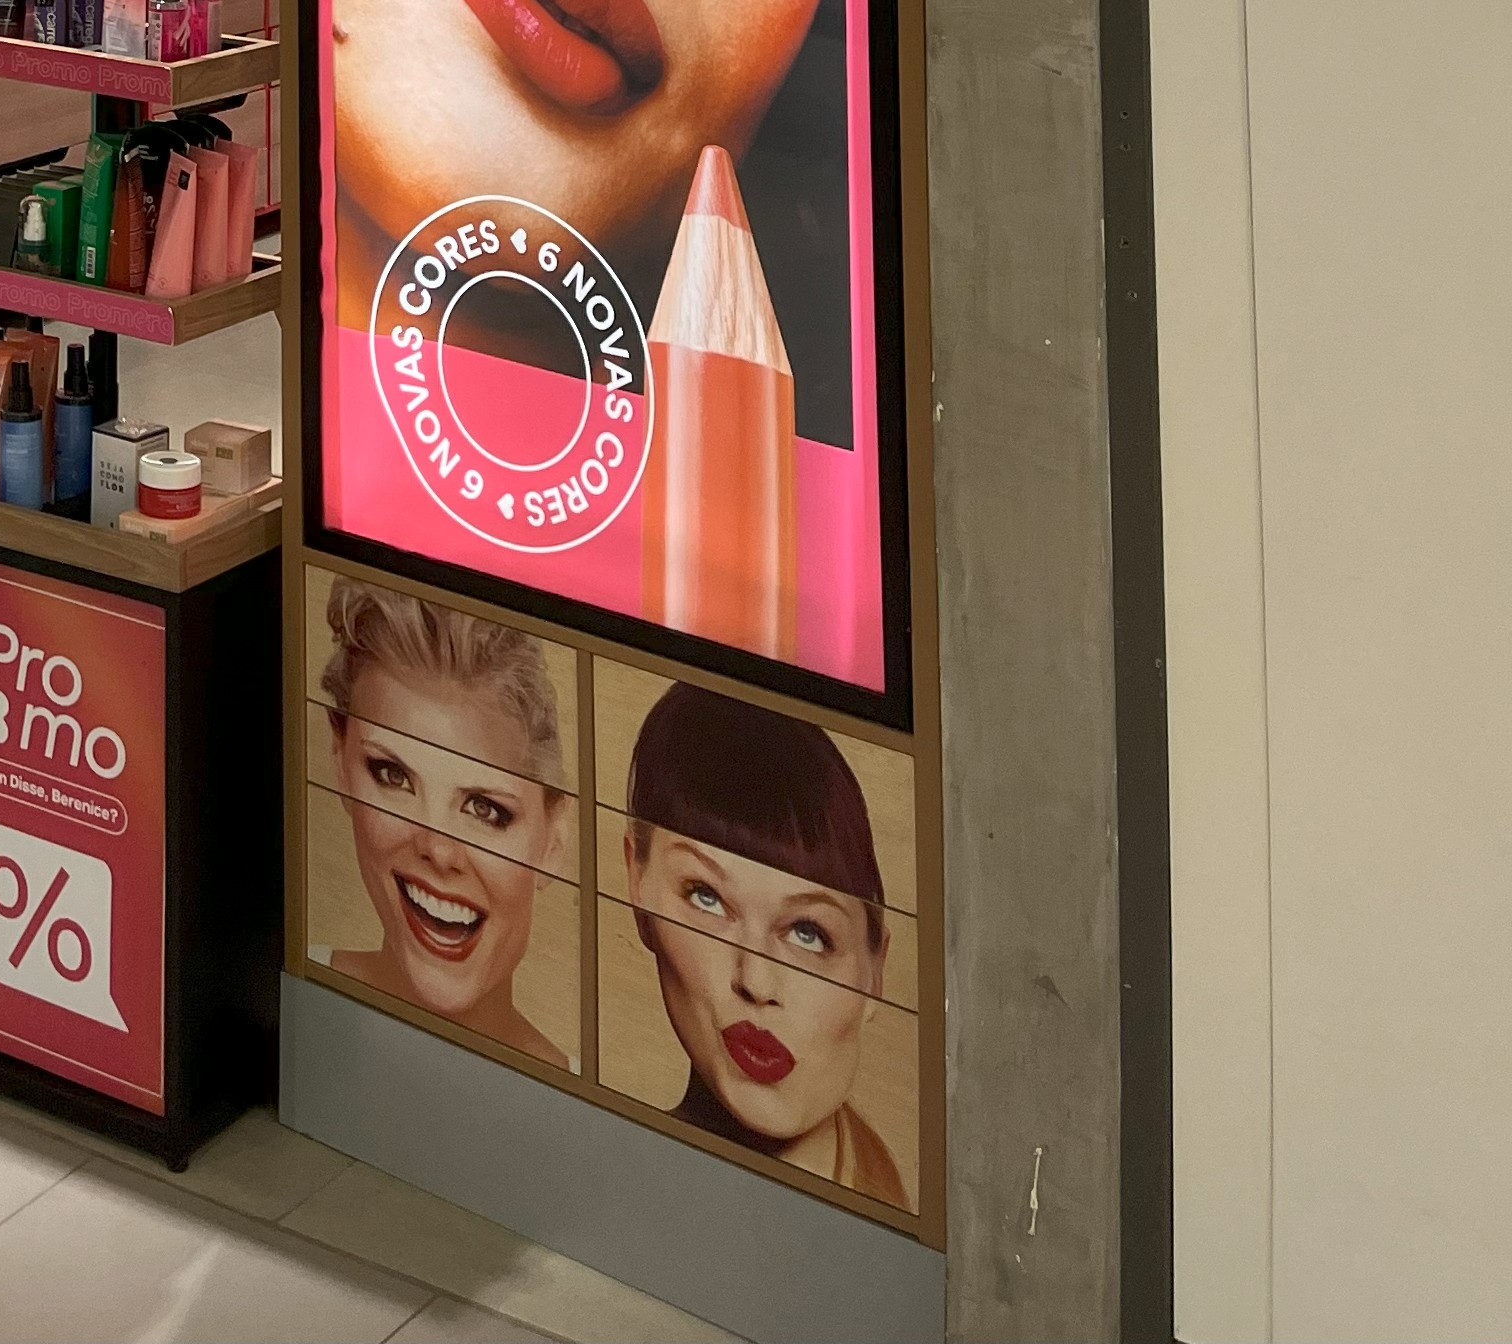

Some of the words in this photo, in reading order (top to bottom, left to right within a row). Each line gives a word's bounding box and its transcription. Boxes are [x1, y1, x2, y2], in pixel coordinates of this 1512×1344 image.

[11, 49, 92, 84] Promo
[399, 219, 500, 316] CORES
[536, 241, 562, 273] 6
[562, 262, 634, 424] NOVAS
[391, 325, 461, 479] NOVAS
[100, 479, 125, 494] FLOR
[459, 471, 484, 500] 6
[522, 430, 624, 528] CORES
[20, 703, 126, 779] mo
[10, 774, 49, 803] Disse,
[51, 787, 119, 824] Berenice?
